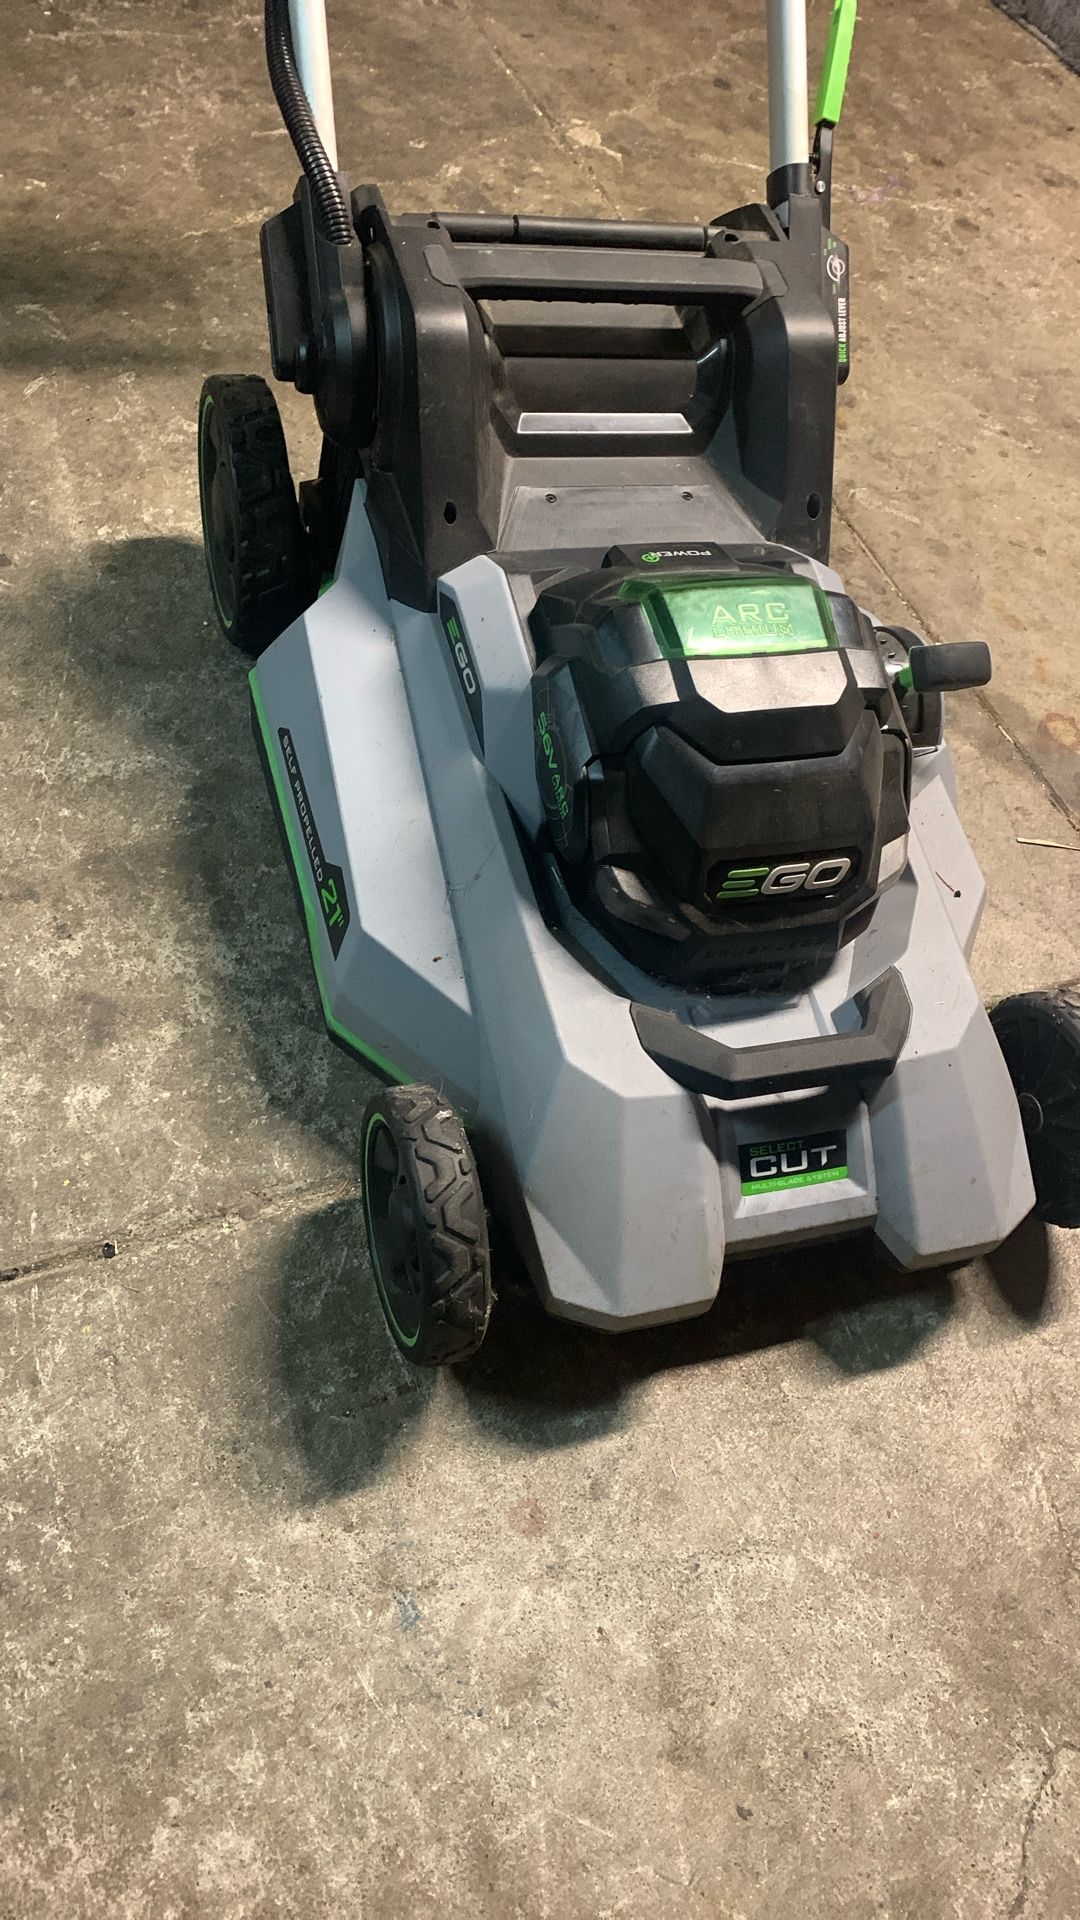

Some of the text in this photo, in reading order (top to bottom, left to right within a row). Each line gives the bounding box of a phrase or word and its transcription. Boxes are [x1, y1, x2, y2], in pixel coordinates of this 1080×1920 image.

[837, 297, 848, 363] QUICK ADJUST LEVER
[712, 602, 790, 625] ARC
[712, 623, 795, 638] LITHIUM
[447, 616, 476, 695] EGO
[537, 711, 558, 769] 56V
[282, 735, 298, 775] SELF
[294, 780, 324, 883] PROPELLED
[716, 857, 852, 899] EGO
[749, 1141, 806, 1157] SELECT
[750, 1144, 837, 1178] CUT
[751, 1170, 840, 1190] MULTI-BLADE SYSTEM
